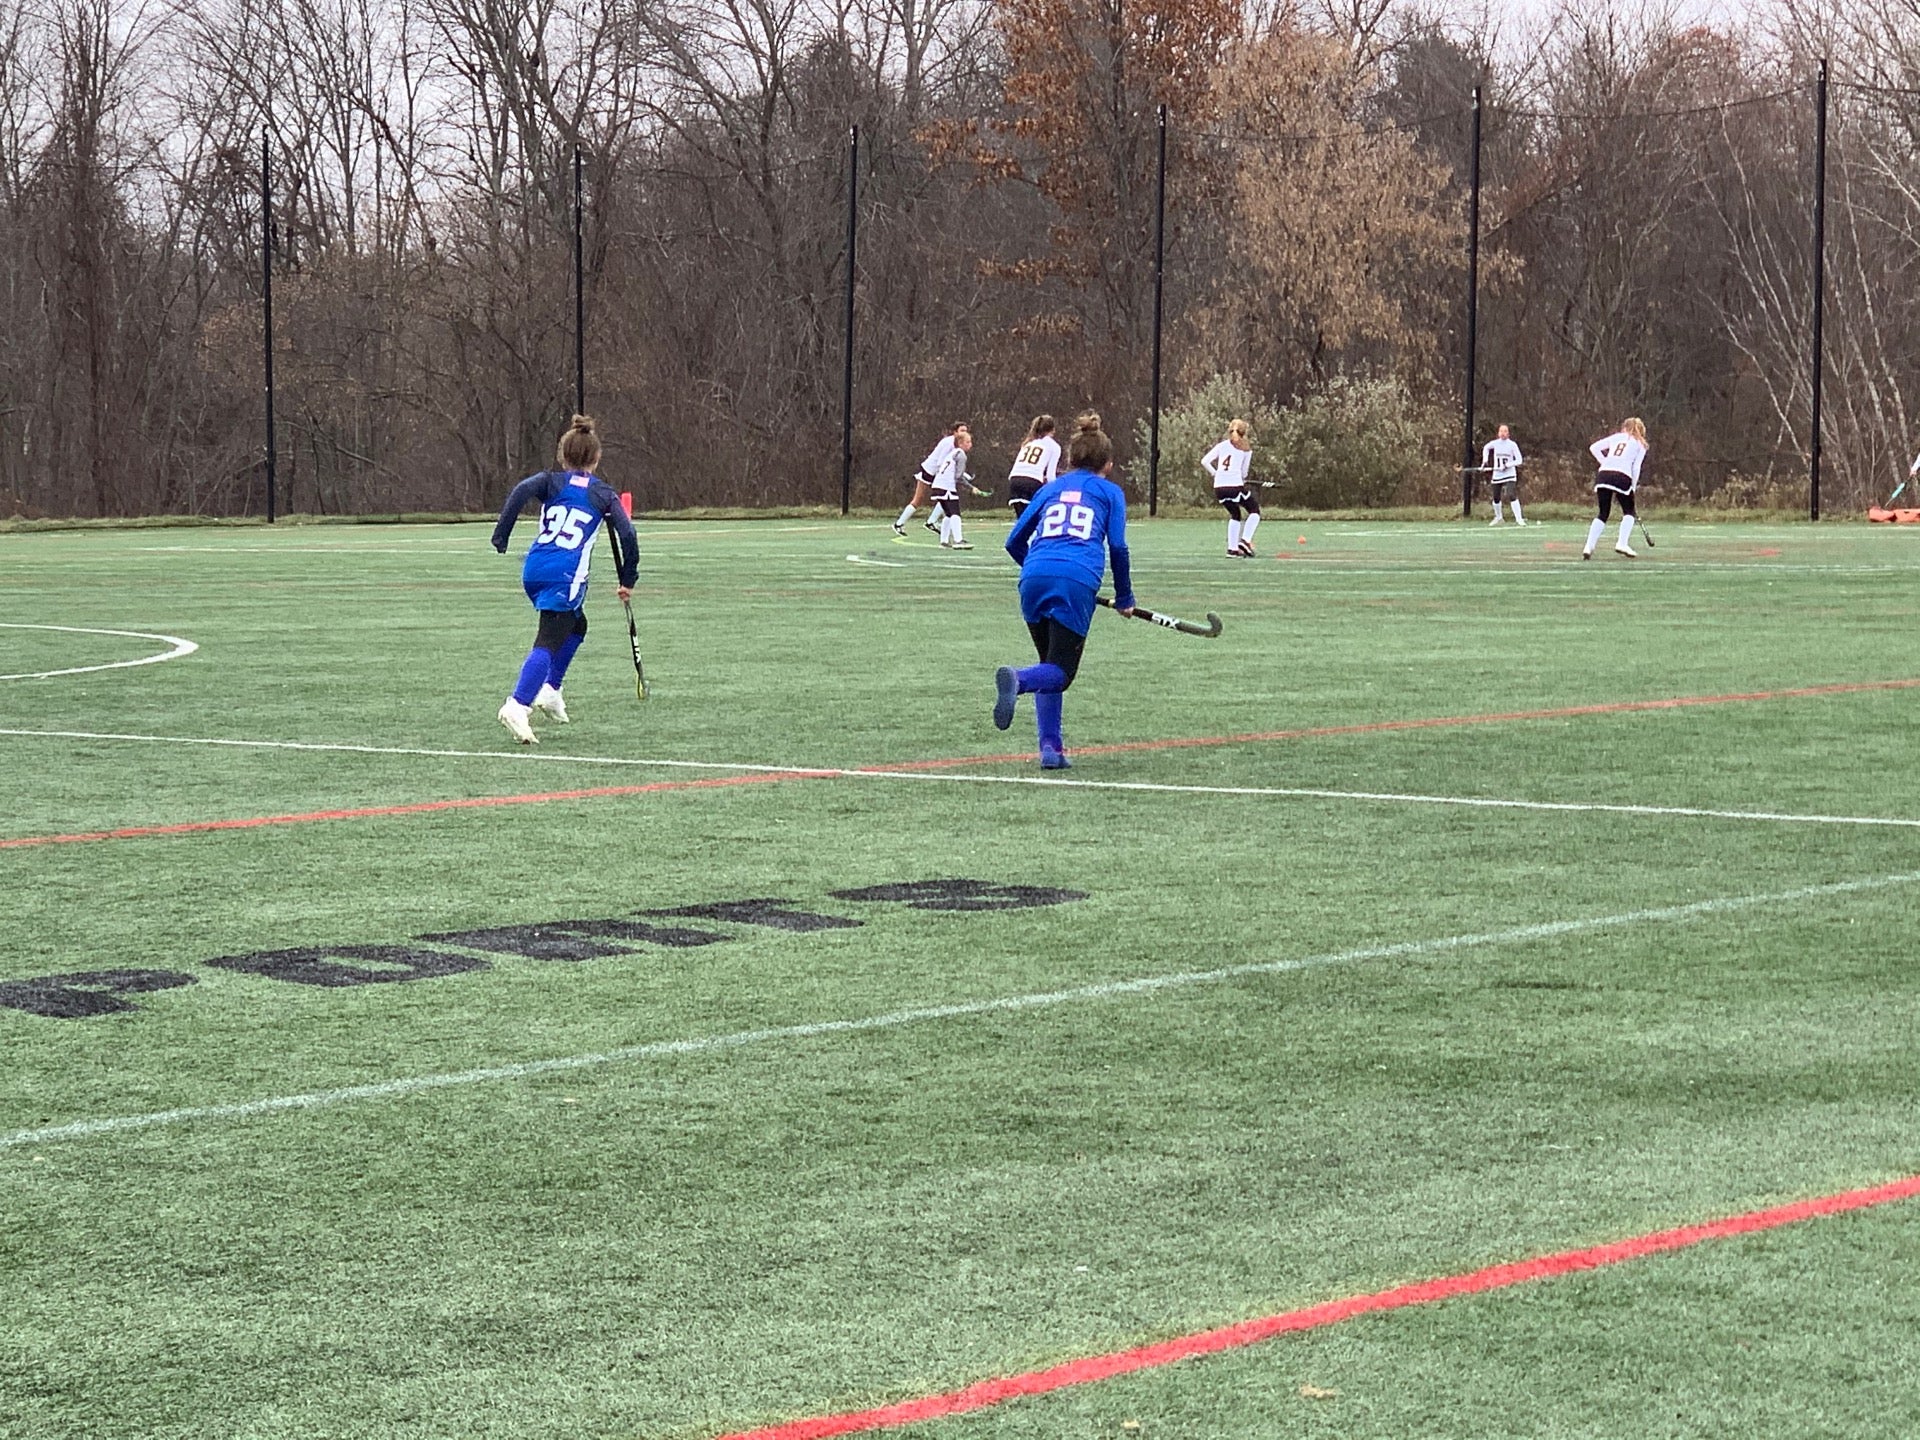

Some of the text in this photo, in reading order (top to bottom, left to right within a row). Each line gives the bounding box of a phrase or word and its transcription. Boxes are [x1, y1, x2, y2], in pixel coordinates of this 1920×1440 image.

[1018, 446, 1044, 465] 38
[1613, 443, 1627, 457] 8
[1222, 454, 1232, 471] 4
[538, 505, 593, 550] 35
[1042, 503, 1094, 540] 29
[1152, 612, 1181, 630] STX
